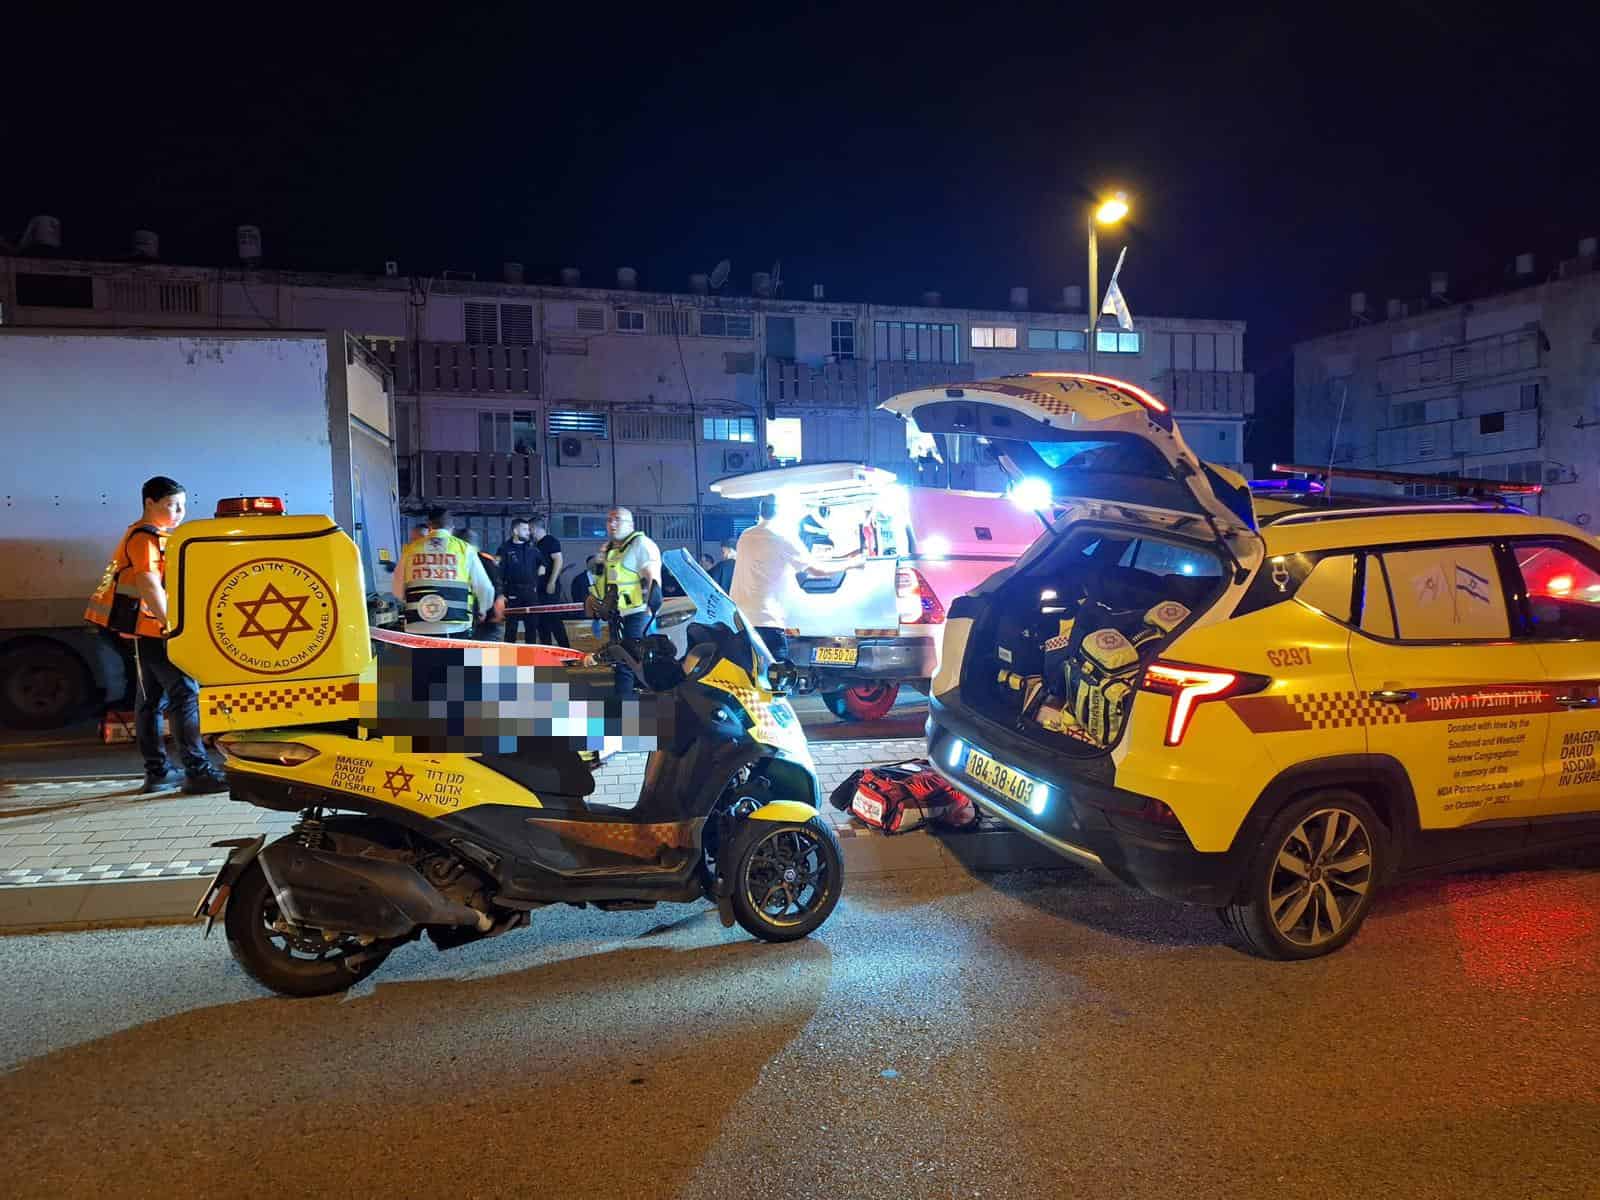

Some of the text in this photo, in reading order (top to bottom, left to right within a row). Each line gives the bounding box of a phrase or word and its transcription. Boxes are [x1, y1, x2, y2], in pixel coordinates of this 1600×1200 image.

[412, 553, 456, 565] חובש
[412, 566, 456, 579] הצלה
[217, 562, 325, 609] מגן דוד אדום בישראל
[216, 614, 329, 668] MAGEN DAVID ADOM IN ISRAEL
[1266, 648, 1312, 667] 6297
[1560, 744, 1594, 759] DAVID
[334, 763, 366, 775] DAVID
[336, 755, 373, 768] MAGEN
[1562, 758, 1596, 773] ADOM
[334, 771, 365, 783] ADOM
[426, 769, 465, 784] מגן דוד
[1559, 772, 1600, 786] IN ISRA
[331, 776, 376, 793] IN ISRAEL
[434, 783, 463, 795] אדום
[417, 790, 459, 807] בישראל
